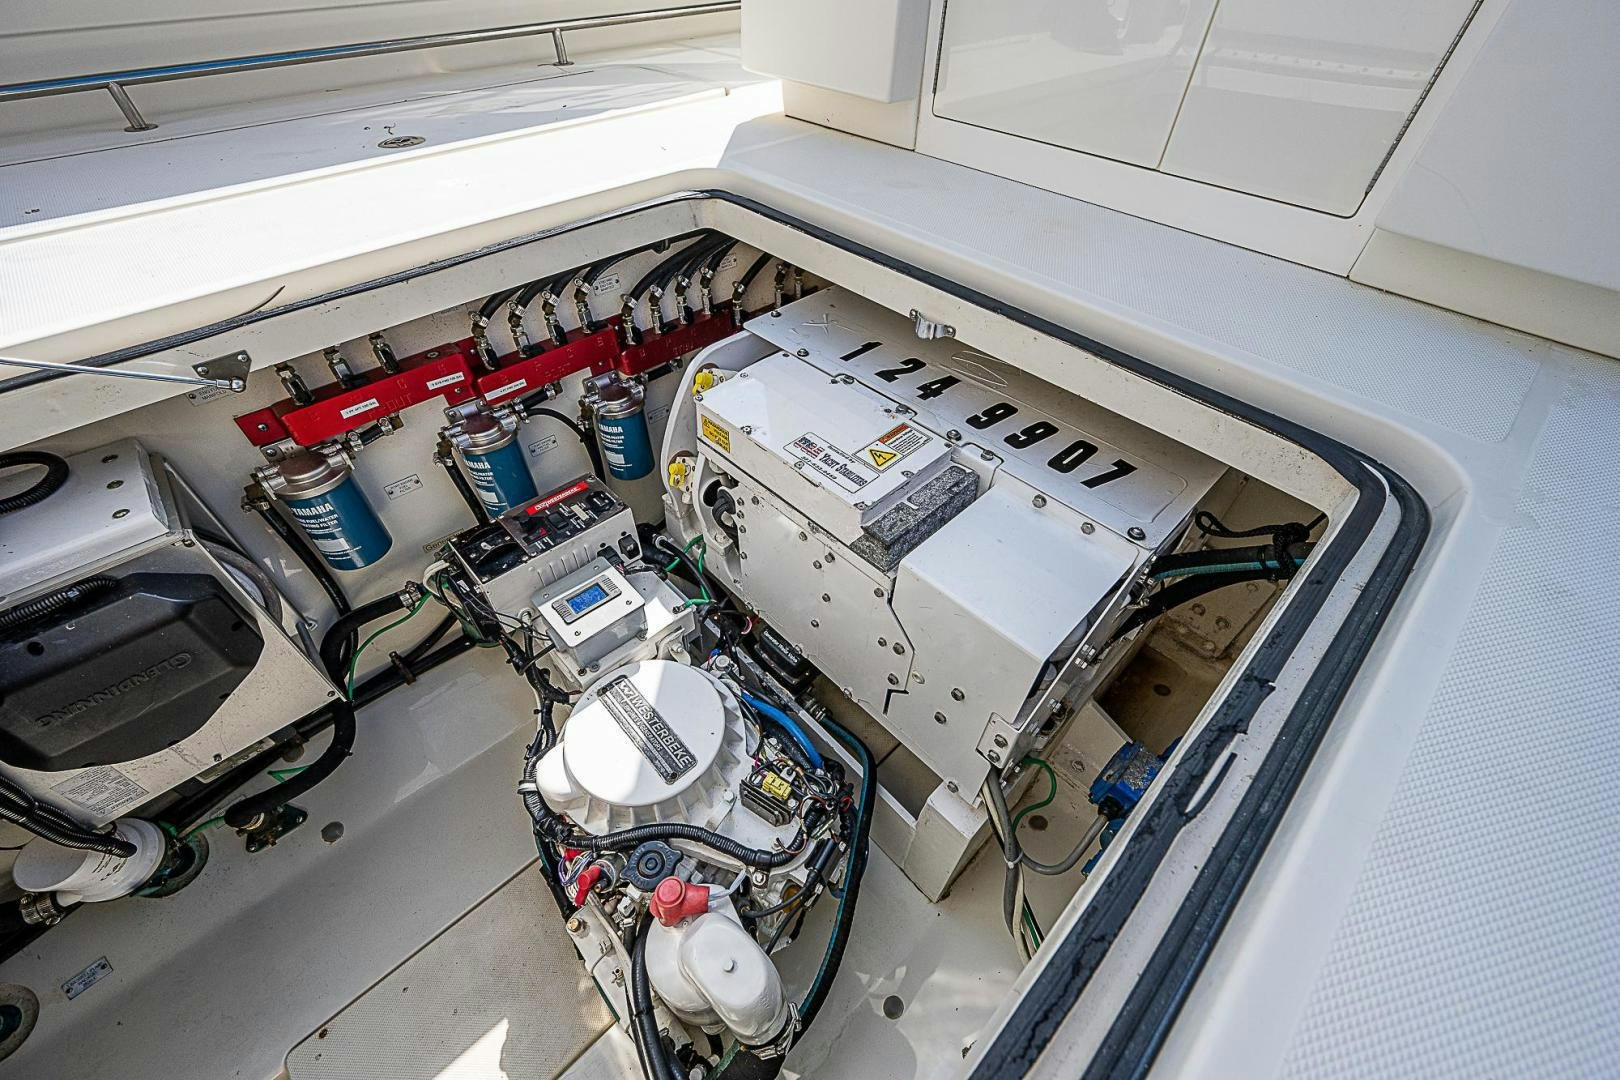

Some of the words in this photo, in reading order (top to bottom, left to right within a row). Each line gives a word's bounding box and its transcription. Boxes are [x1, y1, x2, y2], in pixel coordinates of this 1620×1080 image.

[965, 402, 1138, 489] 9907
[34, 652, 192, 729] GLENDINNING
[632, 694, 693, 767] WESTERBEKE
